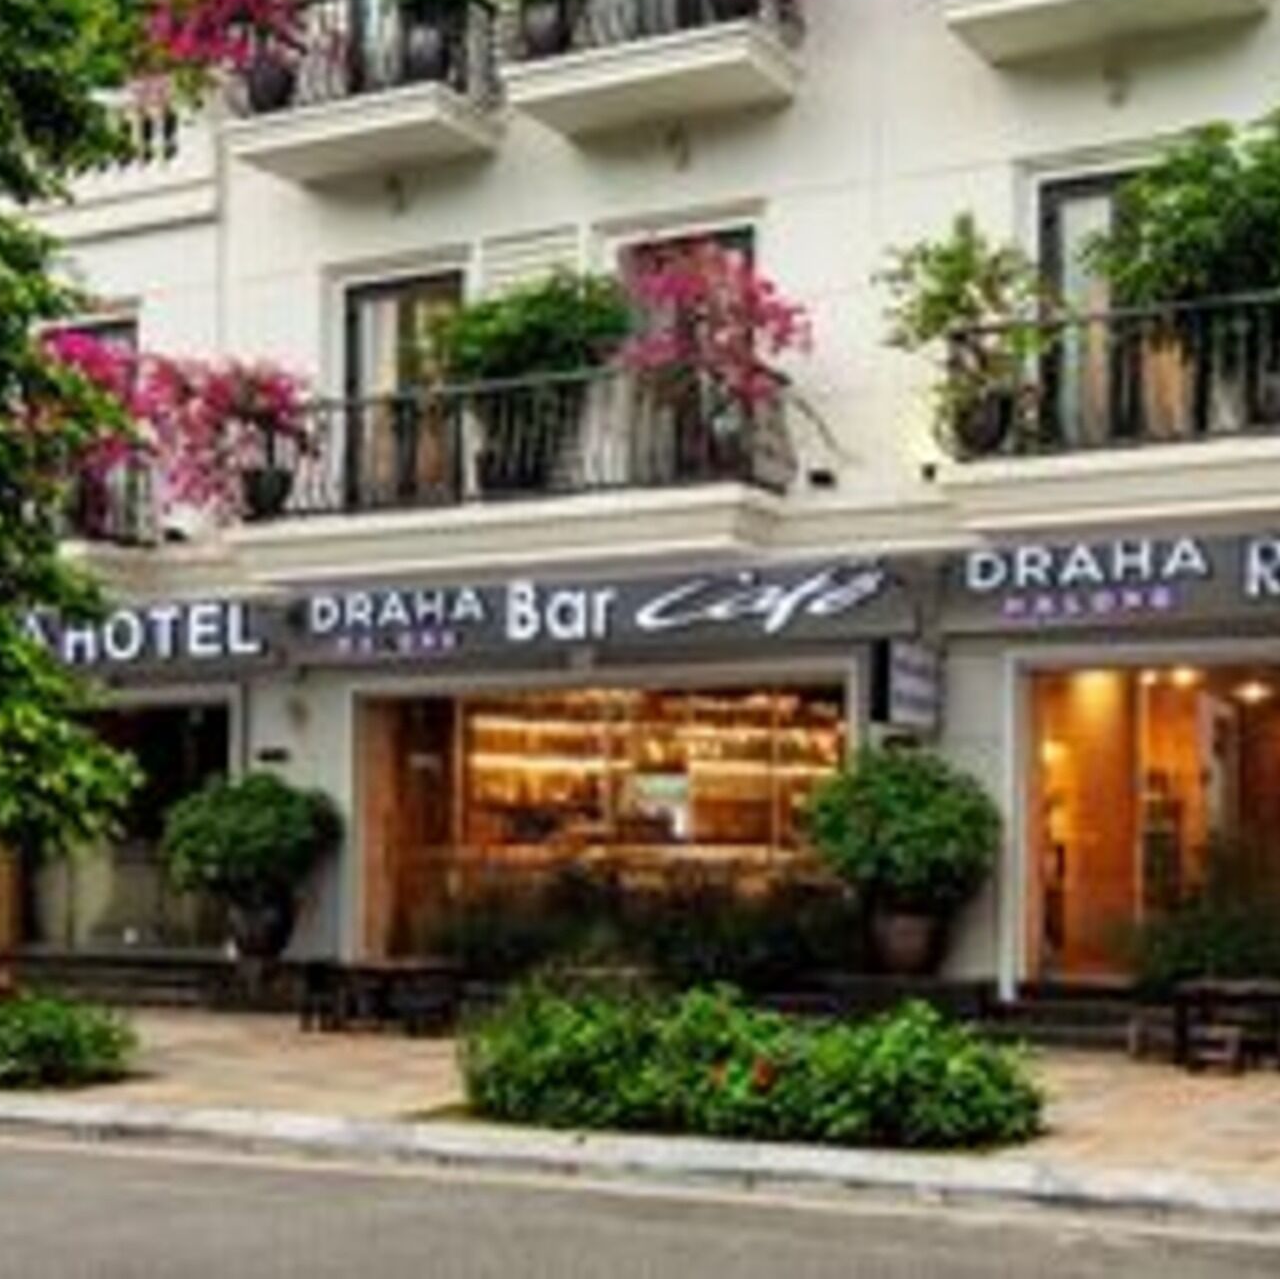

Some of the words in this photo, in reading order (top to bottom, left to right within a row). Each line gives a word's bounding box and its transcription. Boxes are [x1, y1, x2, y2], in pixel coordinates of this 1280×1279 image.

[966, 535, 1209, 591] DRAHA
[63, 601, 260, 663] HOTEL
[310, 586, 484, 634] DRAHA
[506, 580, 618, 642] Bar
